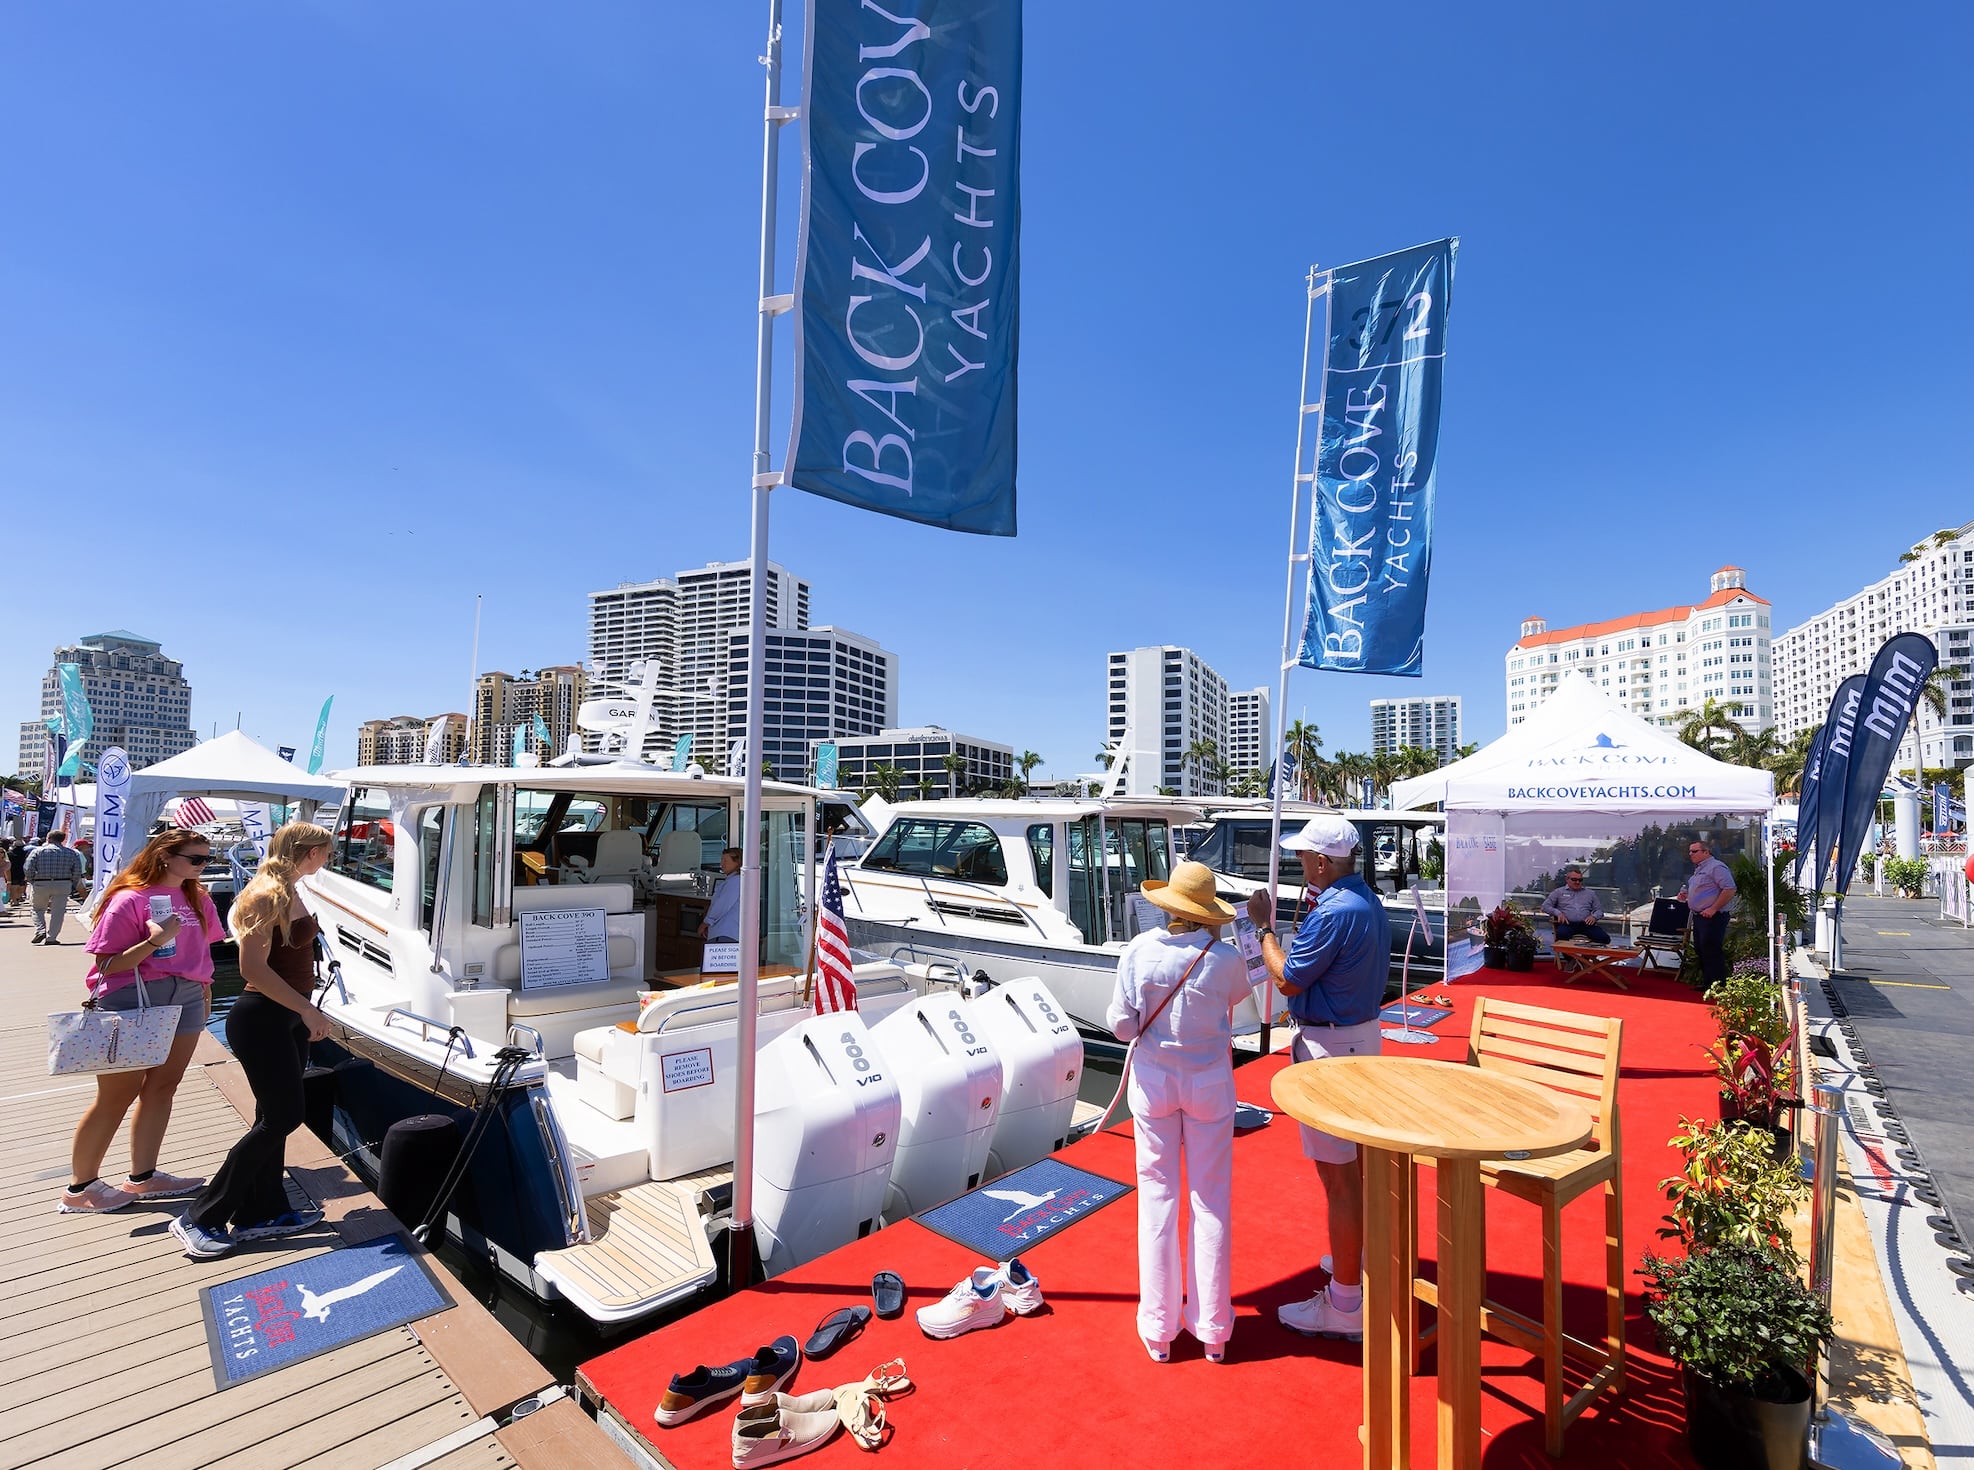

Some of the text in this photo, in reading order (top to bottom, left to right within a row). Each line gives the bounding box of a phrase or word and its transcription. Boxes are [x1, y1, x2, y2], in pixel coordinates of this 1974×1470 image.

[944, 79, 1000, 384] YACHTS
[841, 221, 932, 498] BACK
[1322, 382, 1389, 661] BACK COVE
[1383, 450, 1418, 595] YACHTS
[609, 708, 655, 721] GARN
[1508, 785, 1697, 799] BACKCOVEYACHTS.COM
[532, 913, 556, 921] BACK
[557, 911, 580, 920] COVE
[1033, 992, 1058, 1023] 400
[948, 1010, 976, 1045] 400
[1051, 1025, 1069, 1035] V10
[840, 1031, 871, 1072] 400
[966, 1046, 988, 1057] V10
[674, 1061, 701, 1071] REMOVE
[675, 1055, 699, 1065] PLEASE
[665, 1066, 710, 1079] SHOES BEFORE
[672, 1074, 705, 1085] BOARDING
[855, 1073, 882, 1087] V10
[1015, 1193, 1104, 1240] YACHTS
[222, 1294, 259, 1359] YACHTS
